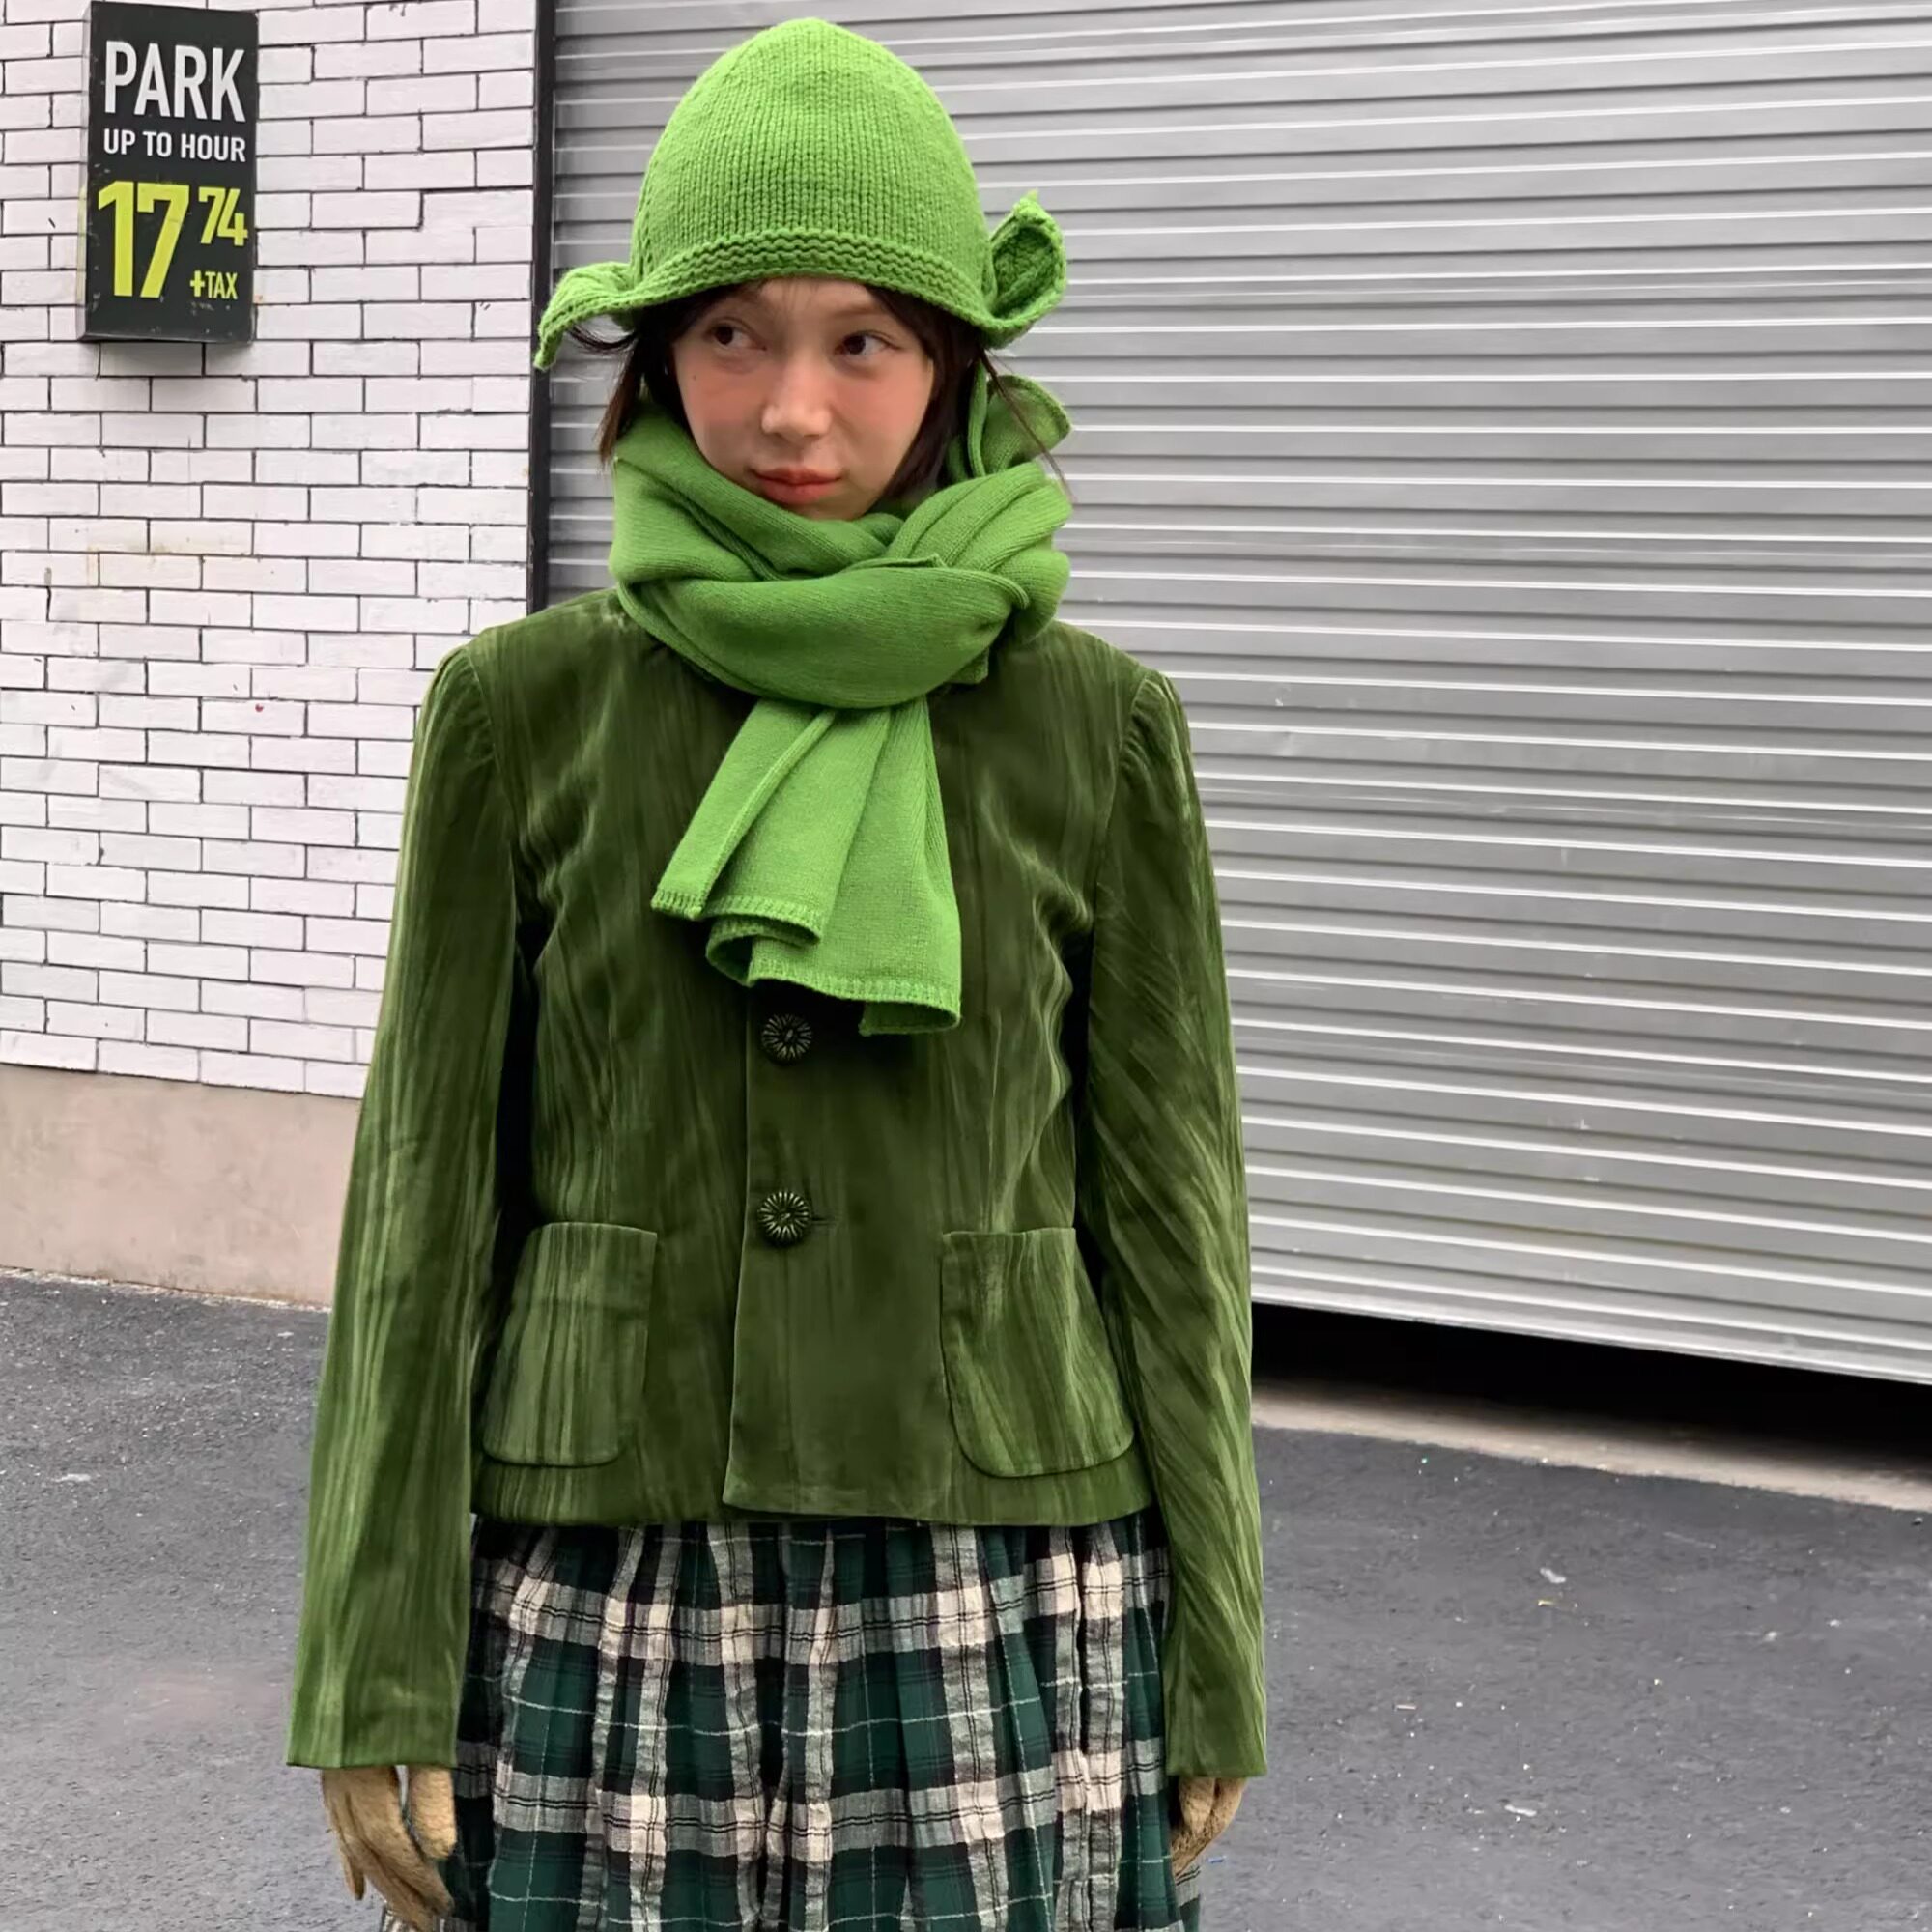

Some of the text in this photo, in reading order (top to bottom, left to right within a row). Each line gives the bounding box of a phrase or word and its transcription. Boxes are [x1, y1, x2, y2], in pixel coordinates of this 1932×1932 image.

[104, 40, 246, 123] PARK
[103, 128, 246, 163] UP TO HOUR
[98, 180, 248, 299] 17 74
[189, 270, 238, 300] +TAX
